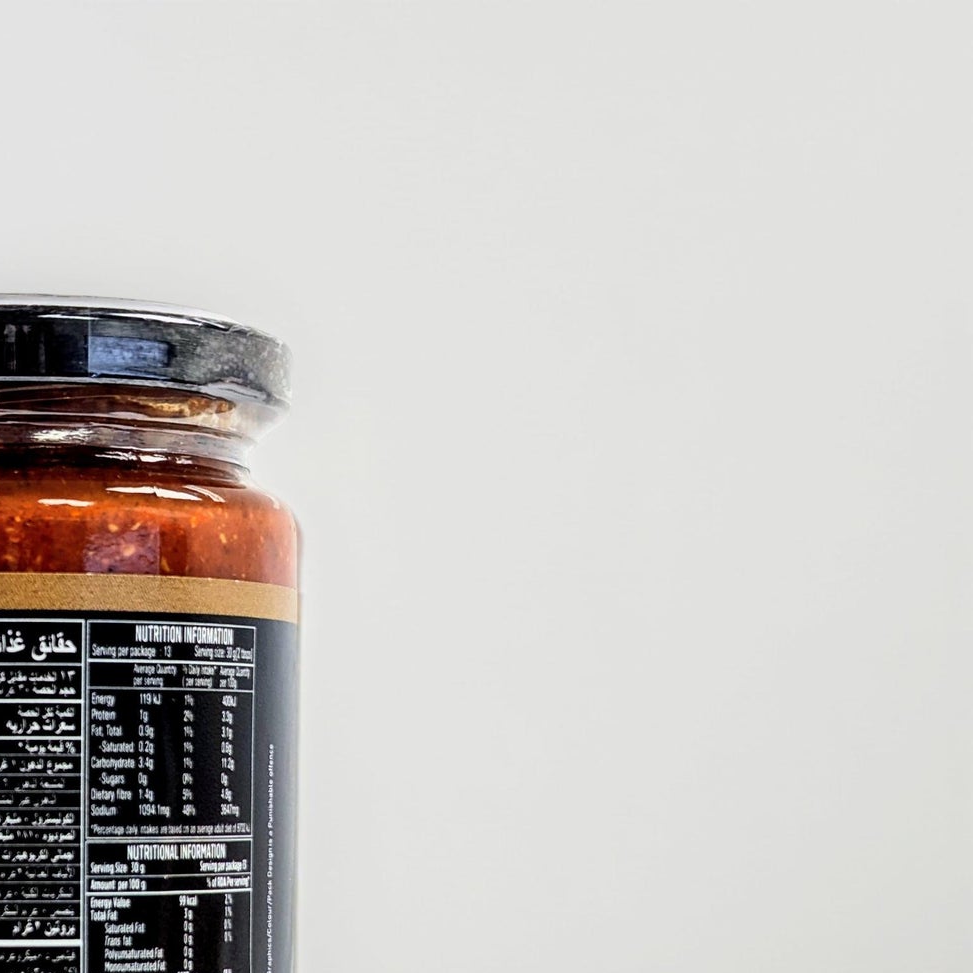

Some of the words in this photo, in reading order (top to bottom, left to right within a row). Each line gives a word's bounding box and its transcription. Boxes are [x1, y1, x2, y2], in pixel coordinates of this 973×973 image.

[135, 625, 182, 644] NUTRITION
[184, 626, 233, 645] INFORMATION
[31, 632, 77, 660] حقائق
[92, 644, 116, 658] Serving
[118, 646, 129, 659] per
[130, 646, 156, 659] package
[91, 692, 115, 706] Energy
[139, 693, 151, 704] 119
[91, 708, 116, 720] Protein
[106, 725, 123, 736] Total
[91, 757, 135, 770] Carbohydrate
[91, 789, 115, 802] Dietary
[117, 788, 132, 800] fibre
[91, 804, 117, 816] Sodium
[127, 844, 179, 860] NUTRITIONAL
[179, 844, 226, 859] INFORMATION
[91, 862, 114, 874] Serving
[115, 862, 127, 872] Size
[91, 879, 116, 890] Amount
[117, 880, 128, 891] per
[91, 897, 113, 910] Energy
[113, 896, 131, 908] Value
[91, 910, 107, 921] Total
[107, 910, 118, 920] Fat
[105, 922, 135, 934] Saturated
